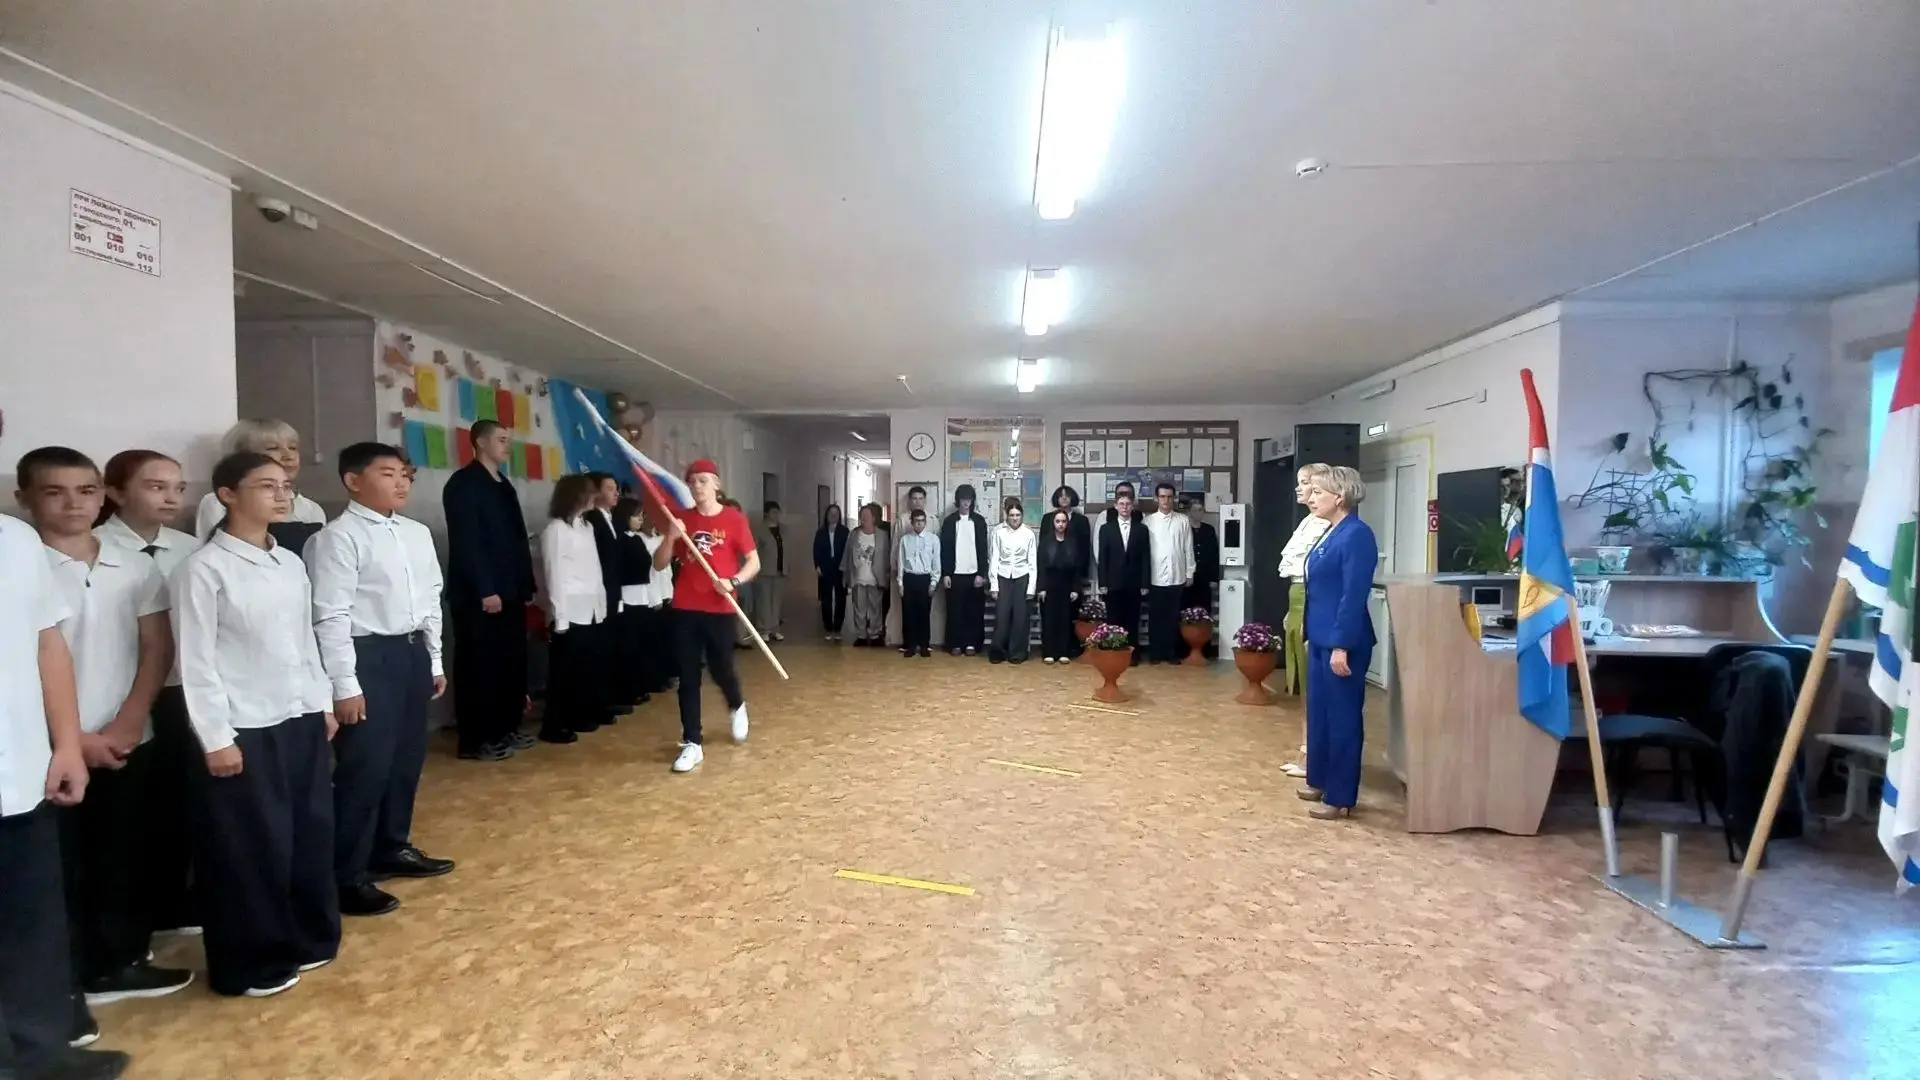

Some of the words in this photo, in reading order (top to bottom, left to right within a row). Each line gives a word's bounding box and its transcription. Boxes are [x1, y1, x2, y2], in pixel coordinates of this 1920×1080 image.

[74, 231, 91, 243] 001
[106, 241, 124, 254] 010
[136, 251, 154, 263] 010
[137, 263, 153, 273] 112
